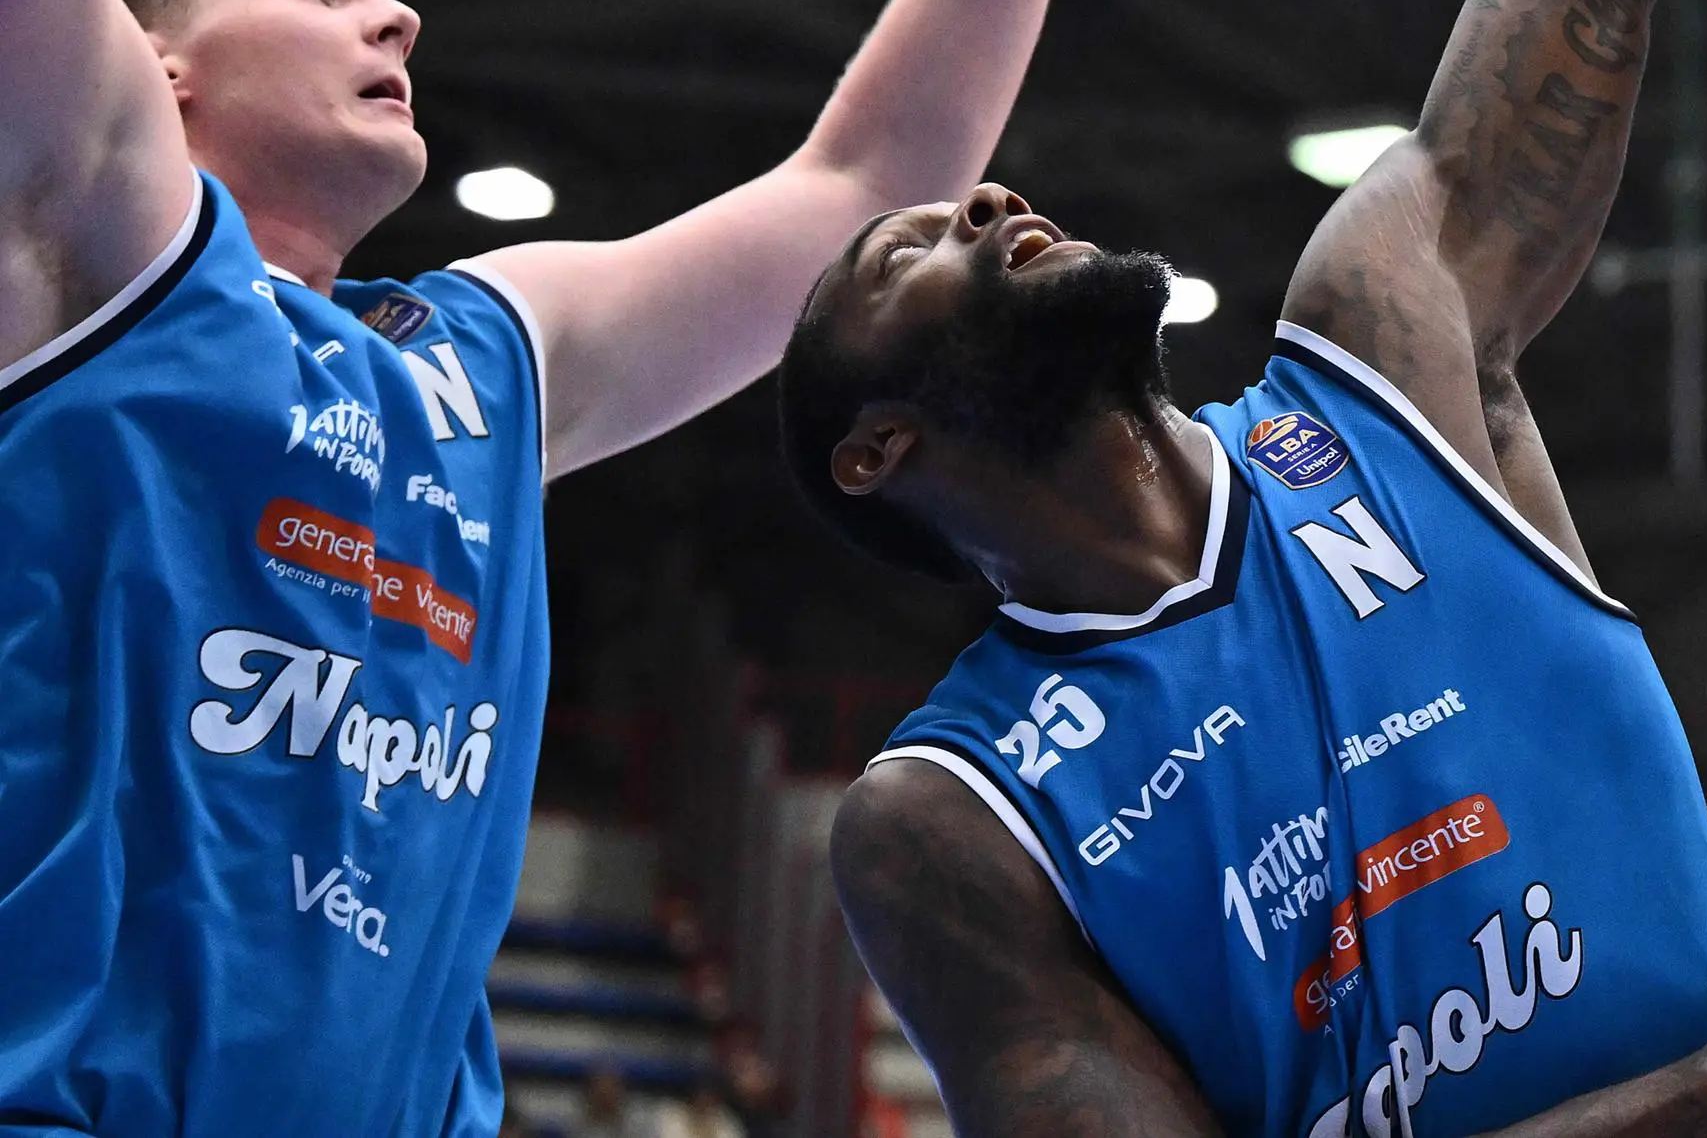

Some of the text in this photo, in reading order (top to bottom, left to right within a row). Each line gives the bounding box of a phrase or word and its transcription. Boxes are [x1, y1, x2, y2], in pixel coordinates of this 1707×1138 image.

[401, 342, 490, 441] N
[1265, 429, 1320, 463] LBA
[1287, 446, 1311, 462] SERIE
[1296, 446, 1339, 476] Unipol
[264, 557, 326, 590] Agenzia
[331, 583, 361, 602] per
[1290, 494, 1426, 620] N
[190, 628, 497, 812] Napoli
[996, 673, 1106, 790] 25
[1078, 705, 1246, 864] GIVOVA
[1357, 811, 1486, 895] vincente
[1309, 882, 1584, 1138] apoli
